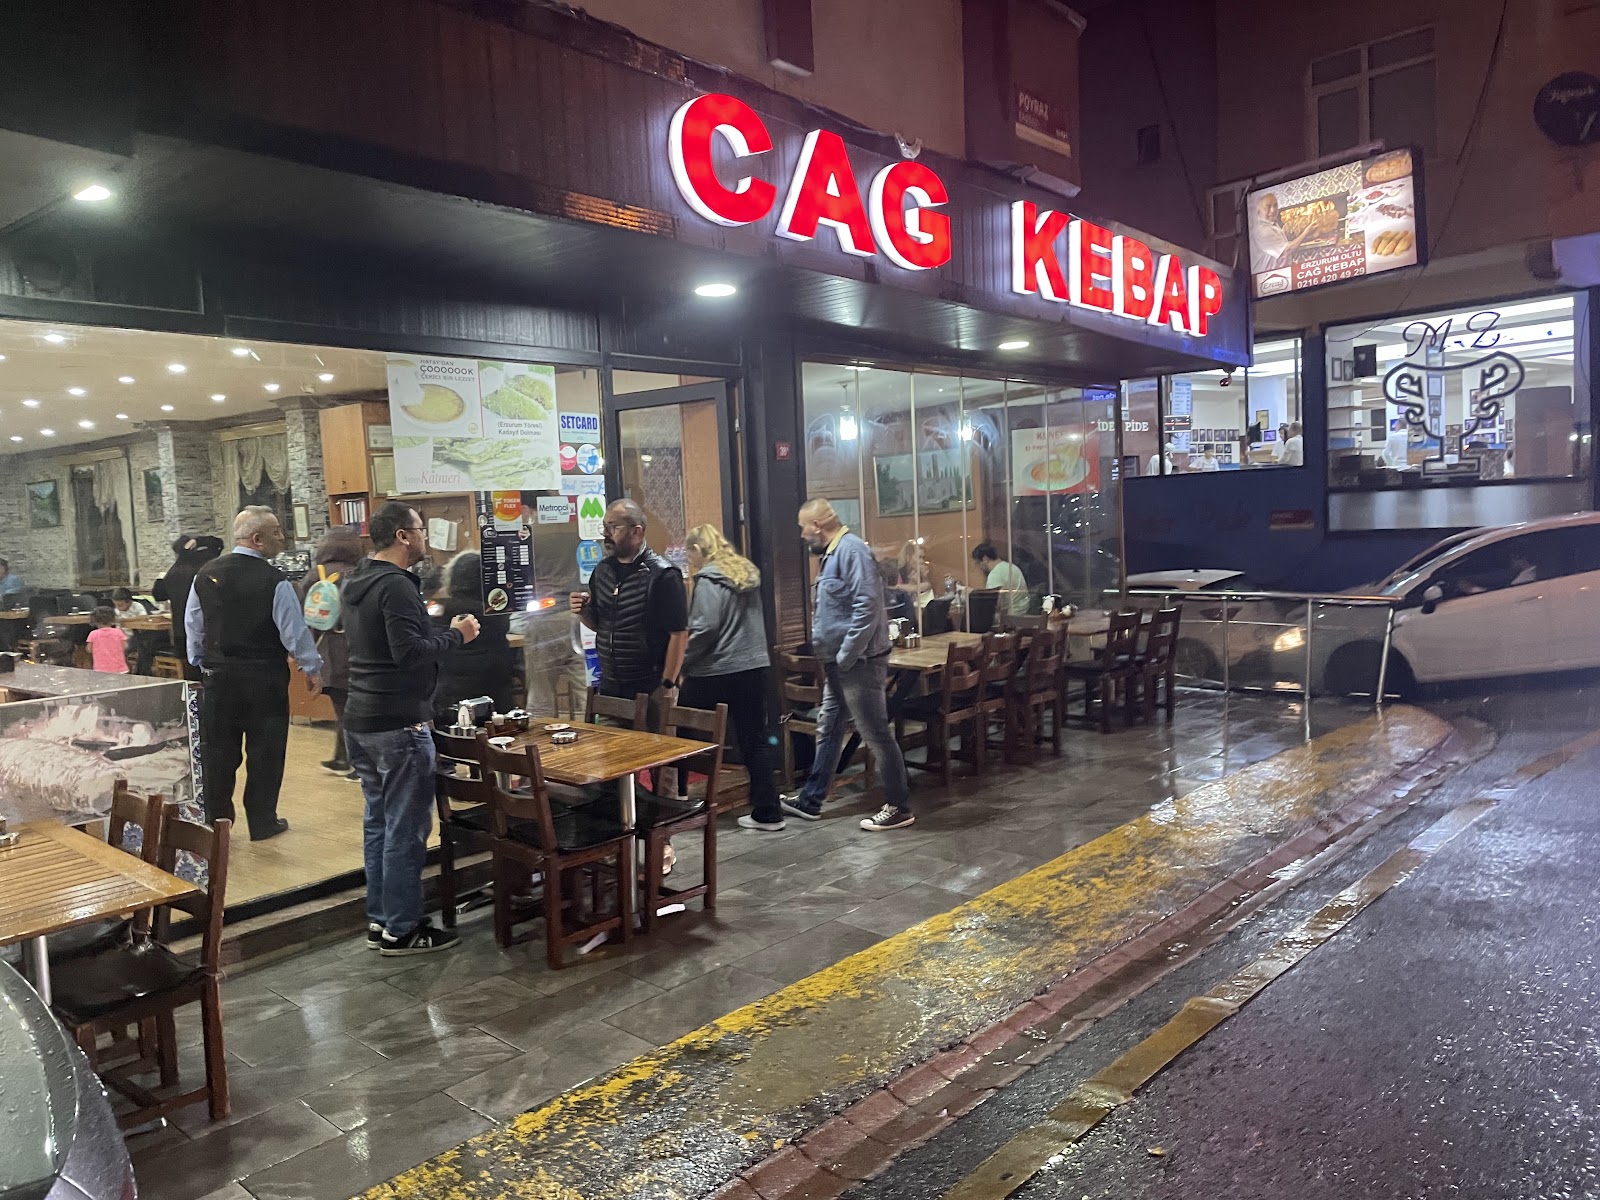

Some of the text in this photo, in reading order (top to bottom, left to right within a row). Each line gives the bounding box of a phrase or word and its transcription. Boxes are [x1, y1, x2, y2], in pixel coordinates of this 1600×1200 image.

[1301, 249, 1362, 269] ERZURUM OLTU
[1011, 200, 1222, 337] KEBAP
[1297, 257, 1365, 279] CAĞ KEBAP
[1297, 267, 1365, 288] 0216 420 49 29
[420, 365, 474, 375] ÇOOOOOOK
[560, 415, 598, 430] SETCARD
[1124, 419, 1149, 432] PİDE
[538, 503, 569, 512] Metropol
